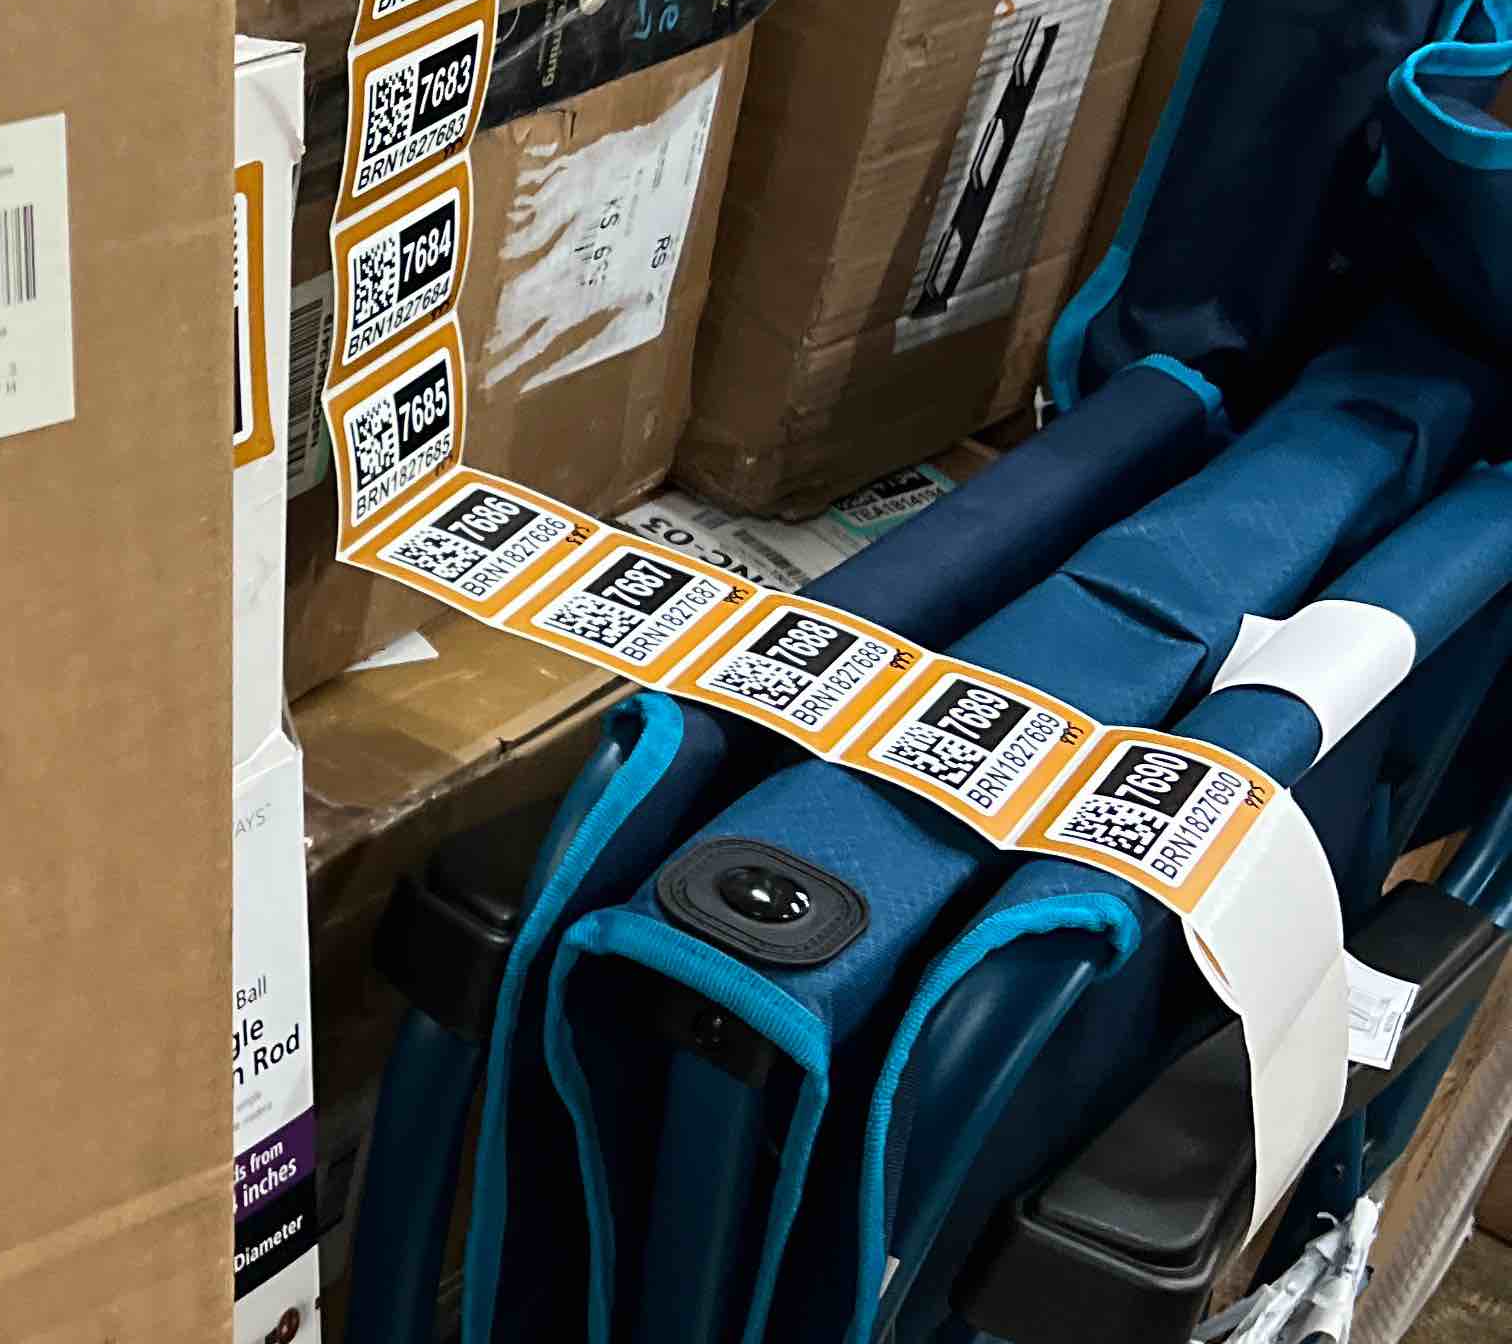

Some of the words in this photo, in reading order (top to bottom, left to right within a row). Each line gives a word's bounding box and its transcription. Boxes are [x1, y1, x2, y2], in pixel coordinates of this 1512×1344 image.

[419, 54, 472, 114] 7683
[358, 114, 466, 190] BRN1827683
[402, 219, 452, 282] 7684
[348, 277, 450, 359] BRN1827684
[398, 378, 447, 442] 7685
[356, 434, 450, 519] BRN1827685
[448, 497, 520, 541] 7686
[461, 517, 567, 597] BRN1827686
[601, 559, 672, 607] 7687
[620, 579, 723, 662] BRN1827687
[766, 619, 839, 667] 7688
[793, 640, 889, 729] BRN1827688
[937, 688, 1010, 741] 7689
[965, 712, 1062, 811] BRN1827689
[1114, 751, 1189, 806] 7690
[1150, 771, 1243, 881] BRN1827690
[236, 975, 267, 1011] Ball
[253, 1022, 301, 1076] Rod
[242, 1157, 297, 1208] inches
[249, 1141, 284, 1174] from
[233, 1213, 304, 1273] Diameter
